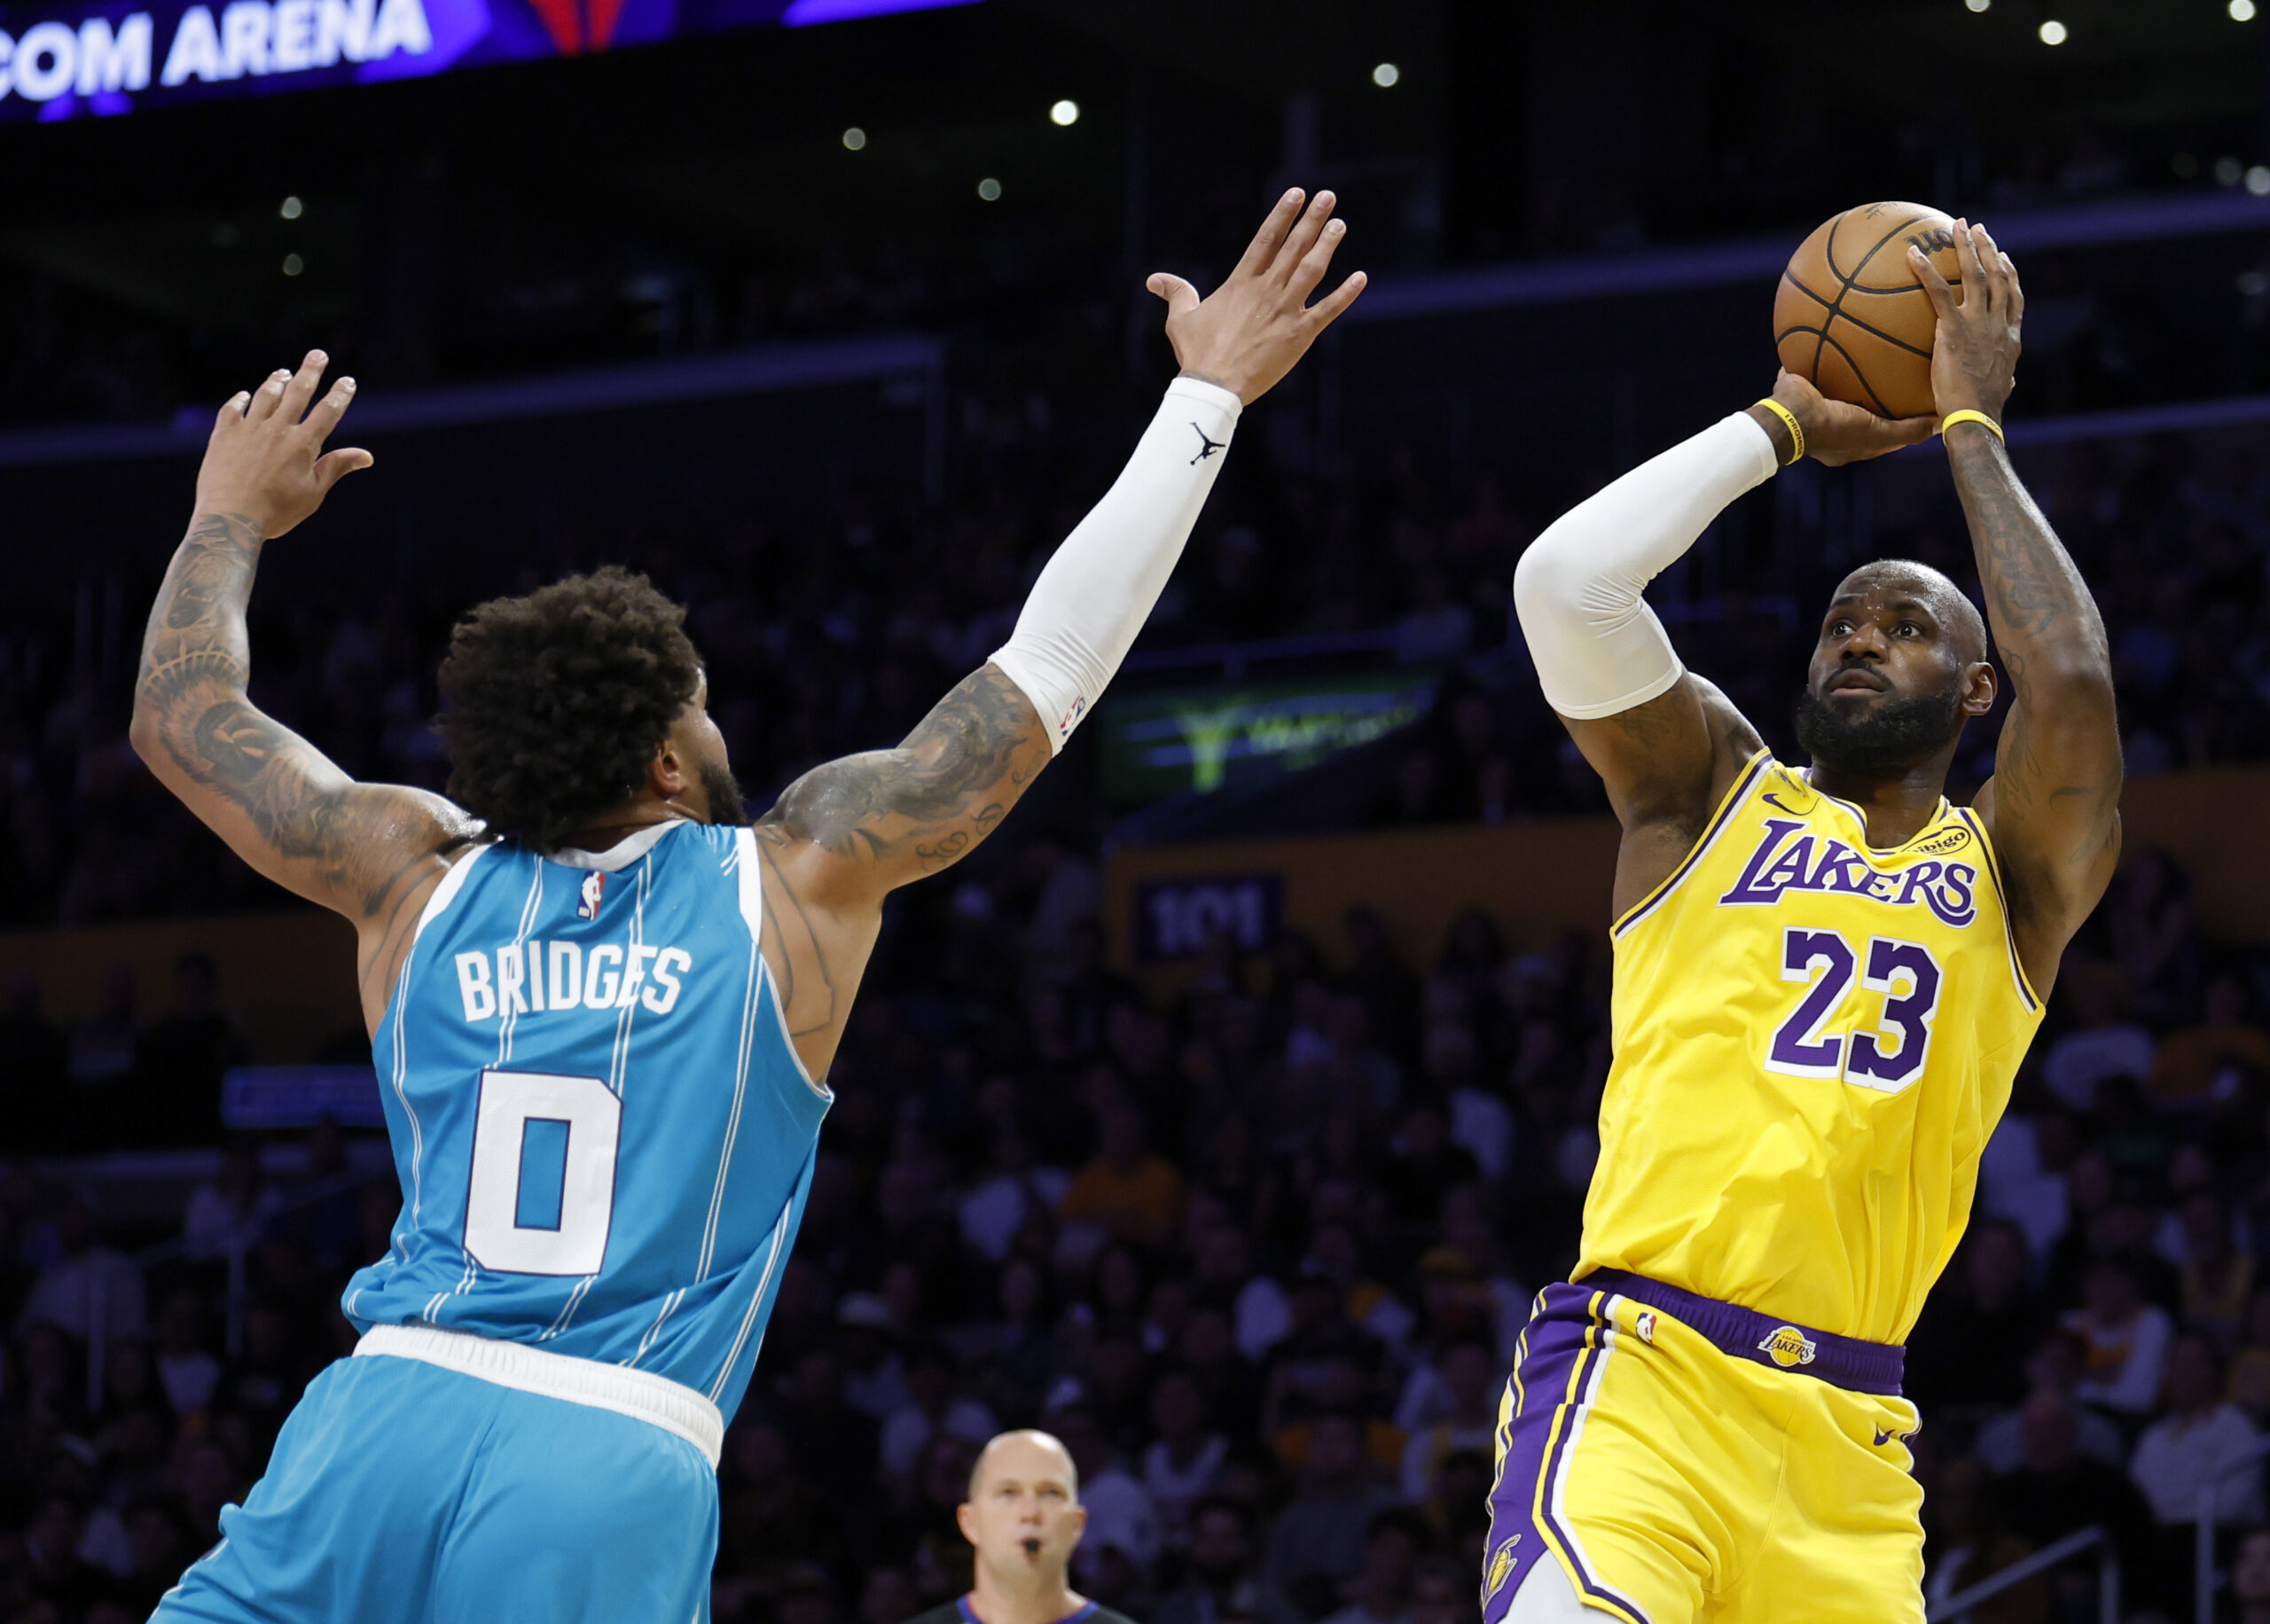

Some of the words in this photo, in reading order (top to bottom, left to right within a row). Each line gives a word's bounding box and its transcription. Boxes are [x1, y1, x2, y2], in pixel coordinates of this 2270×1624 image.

[0, 12, 154, 100] OM
[160, 0, 434, 87] ARENA
[1718, 817, 1978, 929] LAKERS
[454, 941, 693, 1022] BRIDGES
[1764, 925, 1945, 1094] 23
[461, 1068, 624, 1278] 0
[1759, 1331, 1815, 1363] LAKERS
